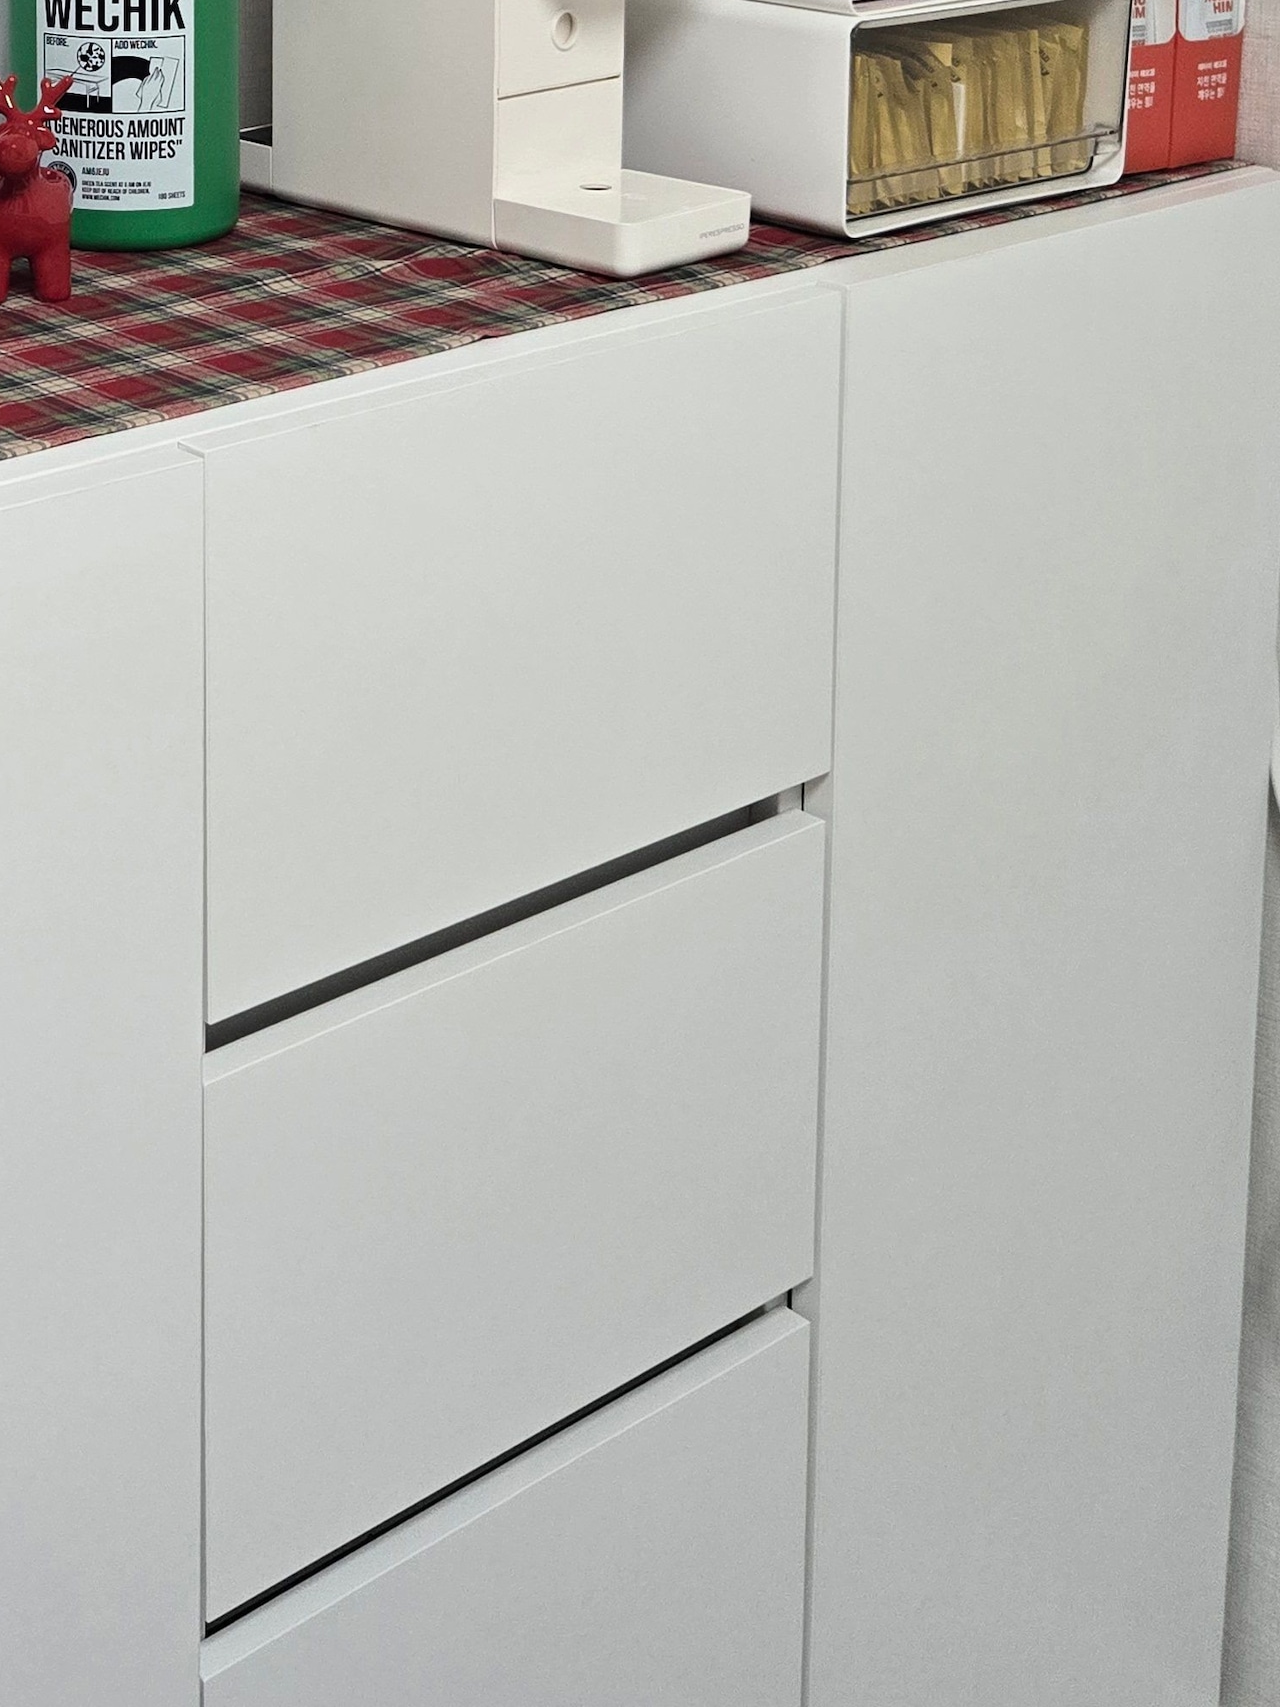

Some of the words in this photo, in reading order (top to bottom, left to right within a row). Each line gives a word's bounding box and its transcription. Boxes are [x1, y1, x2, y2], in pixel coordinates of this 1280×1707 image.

[114, 40, 128, 49] ADD
[54, 117, 124, 138] GENEROUS
[127, 117, 186, 138] AMOUNT
[52, 138, 125, 160] SANITIZER
